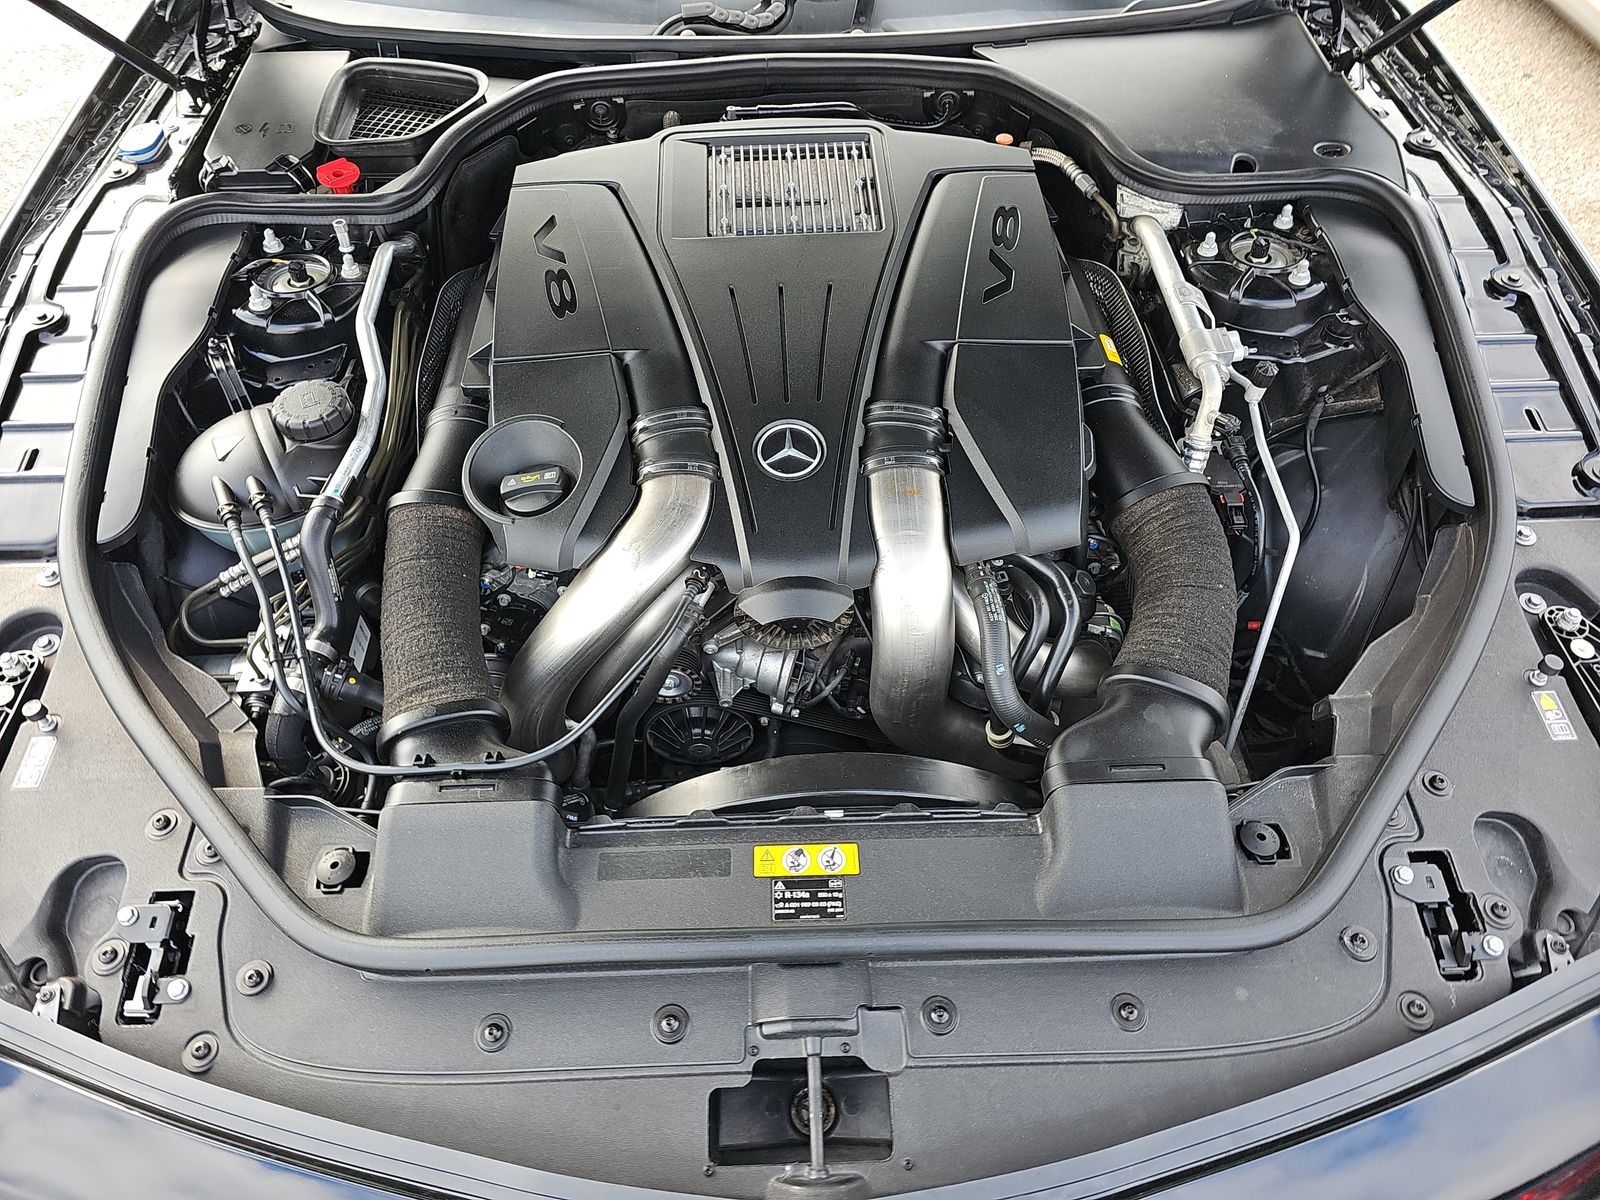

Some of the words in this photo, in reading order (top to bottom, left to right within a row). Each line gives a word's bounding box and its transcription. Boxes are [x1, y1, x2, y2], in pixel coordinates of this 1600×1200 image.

[533, 214, 579, 320] V8
[981, 204, 1021, 305] V8
[784, 891, 810, 899] R-134a
